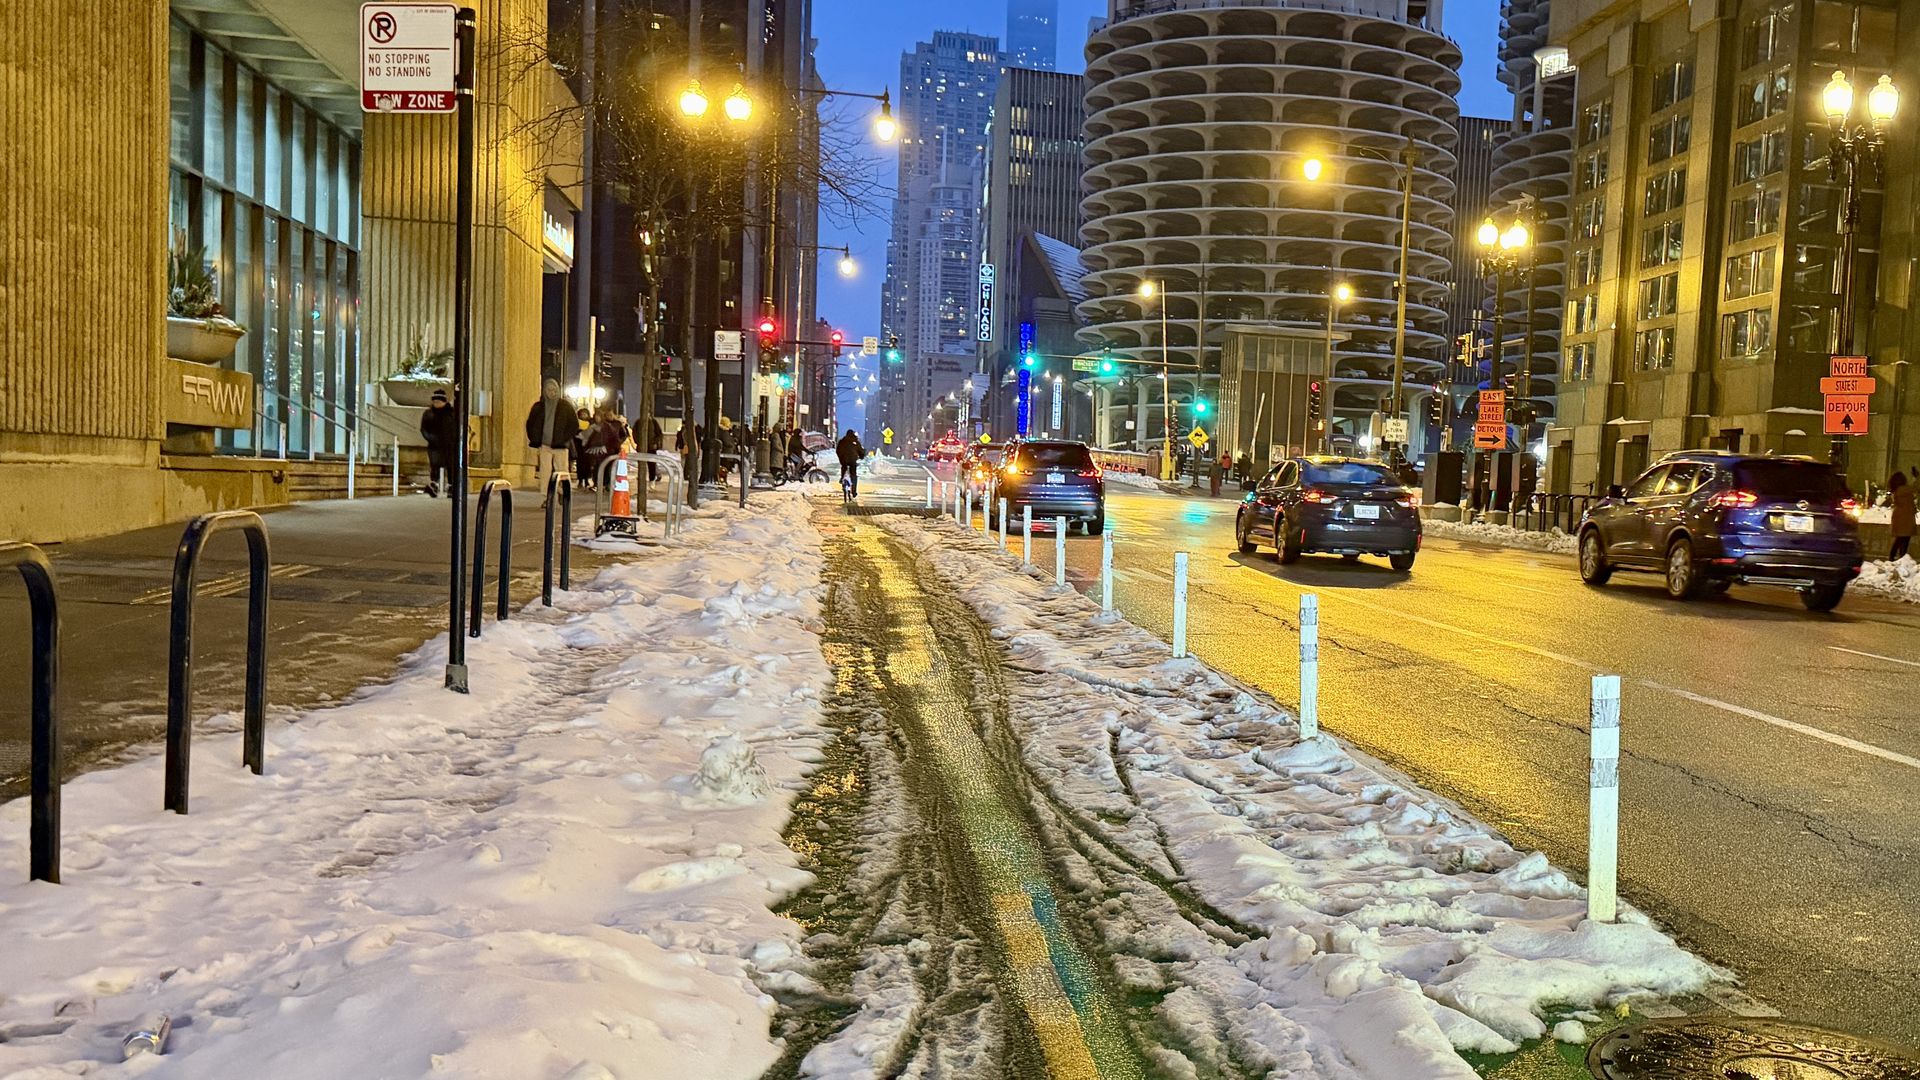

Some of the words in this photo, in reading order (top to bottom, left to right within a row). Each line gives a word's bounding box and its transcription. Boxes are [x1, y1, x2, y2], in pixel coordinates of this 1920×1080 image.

[368, 54, 381, 64] NO
[385, 54, 430, 64] STOPPING
[368, 66, 381, 76] NO
[385, 66, 431, 76] STANDING
[373, 94, 402, 108] TW
[408, 94, 445, 108] ZONE
[980, 284, 991, 339] CHICAGO
[1834, 362, 1866, 374] NORTH
[1836, 380, 1850, 391] STATE
[1828, 402, 1866, 412] DETOUR
